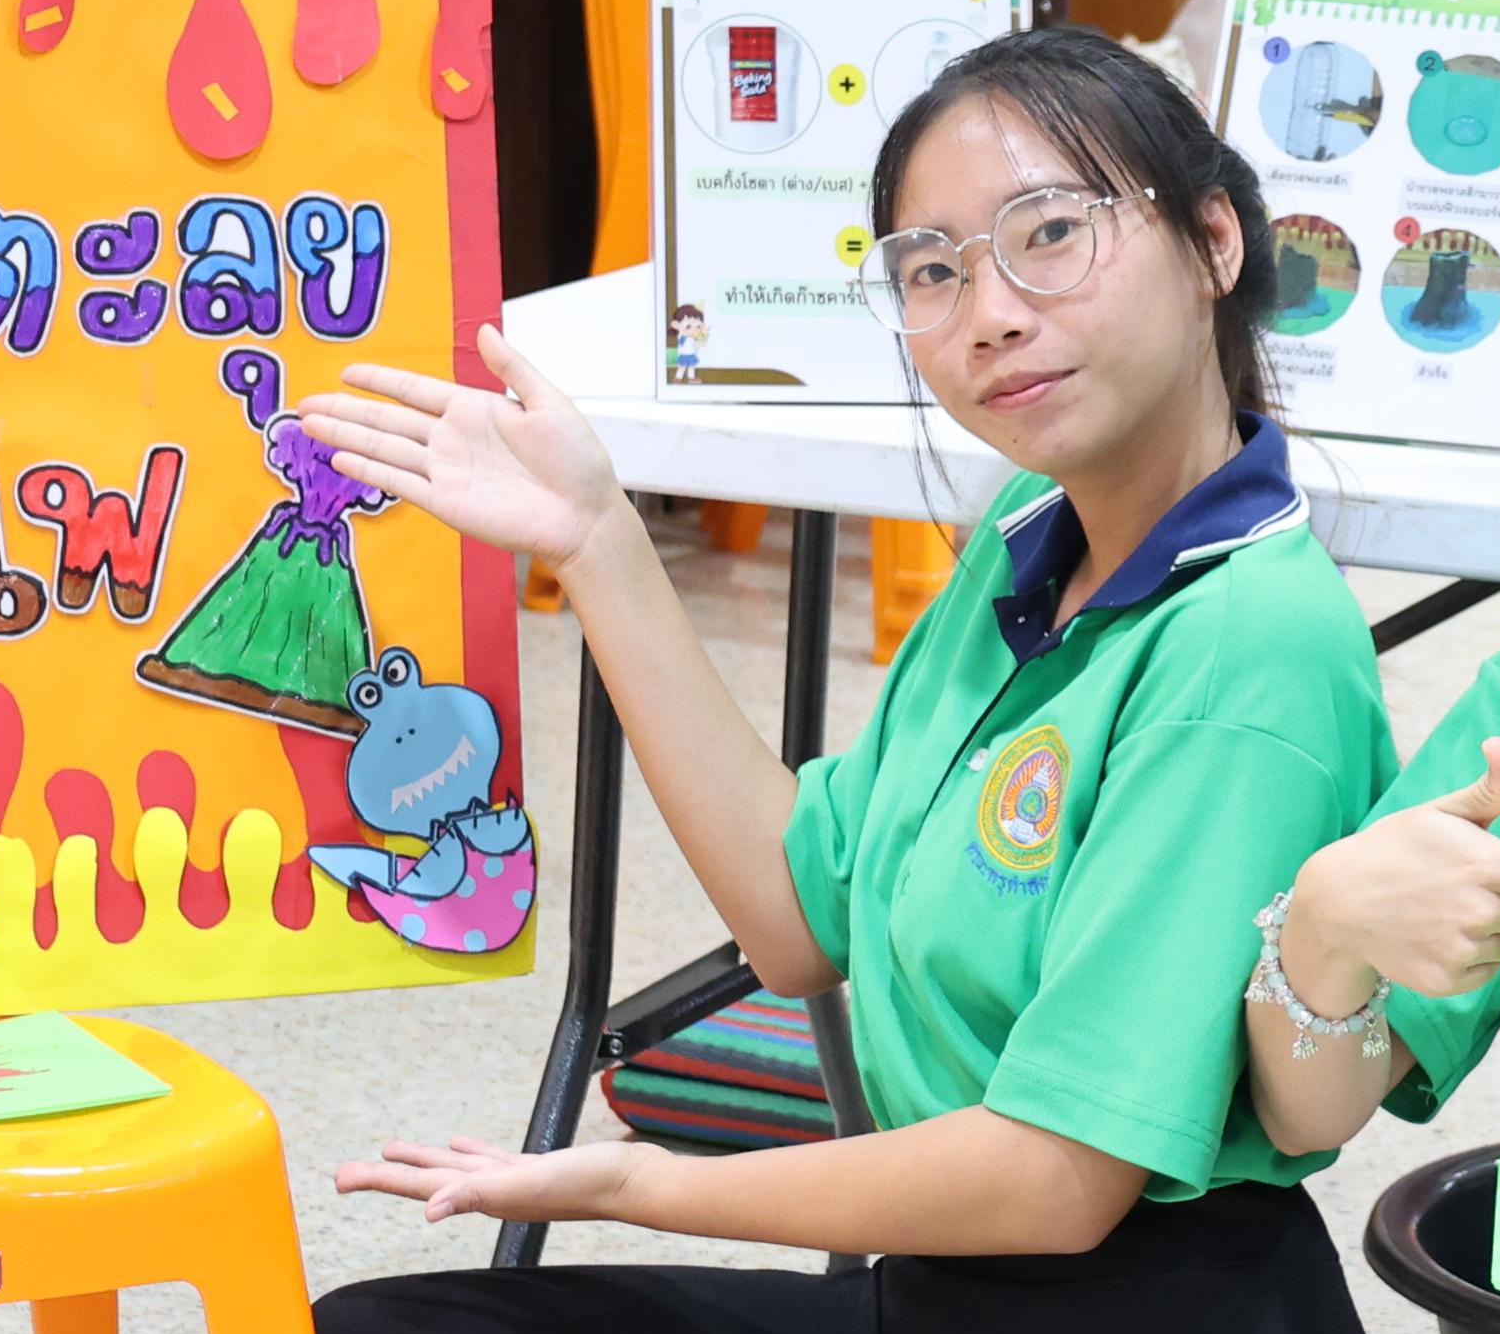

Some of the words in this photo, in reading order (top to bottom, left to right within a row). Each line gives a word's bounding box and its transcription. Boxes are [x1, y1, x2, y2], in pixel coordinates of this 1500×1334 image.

[1271, 44, 1281, 59] 1
[1424, 57, 1436, 72] 2
[1401, 224, 1413, 237] 4
